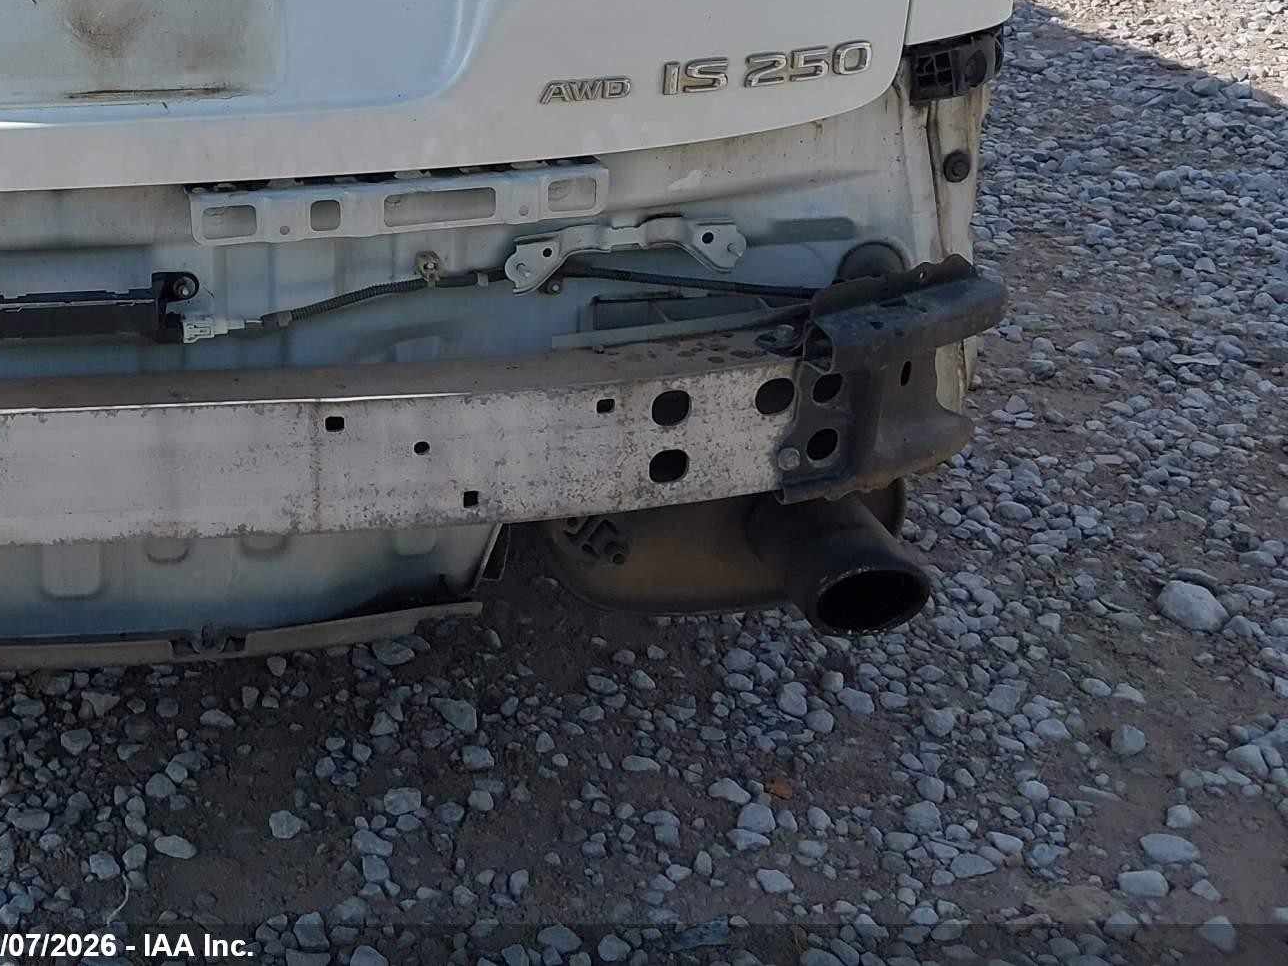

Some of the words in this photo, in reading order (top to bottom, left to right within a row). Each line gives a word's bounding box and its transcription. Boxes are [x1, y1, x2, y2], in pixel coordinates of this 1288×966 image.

[662, 57, 729, 96] IS
[744, 39, 873, 88] 250
[539, 78, 632, 105] AWD
